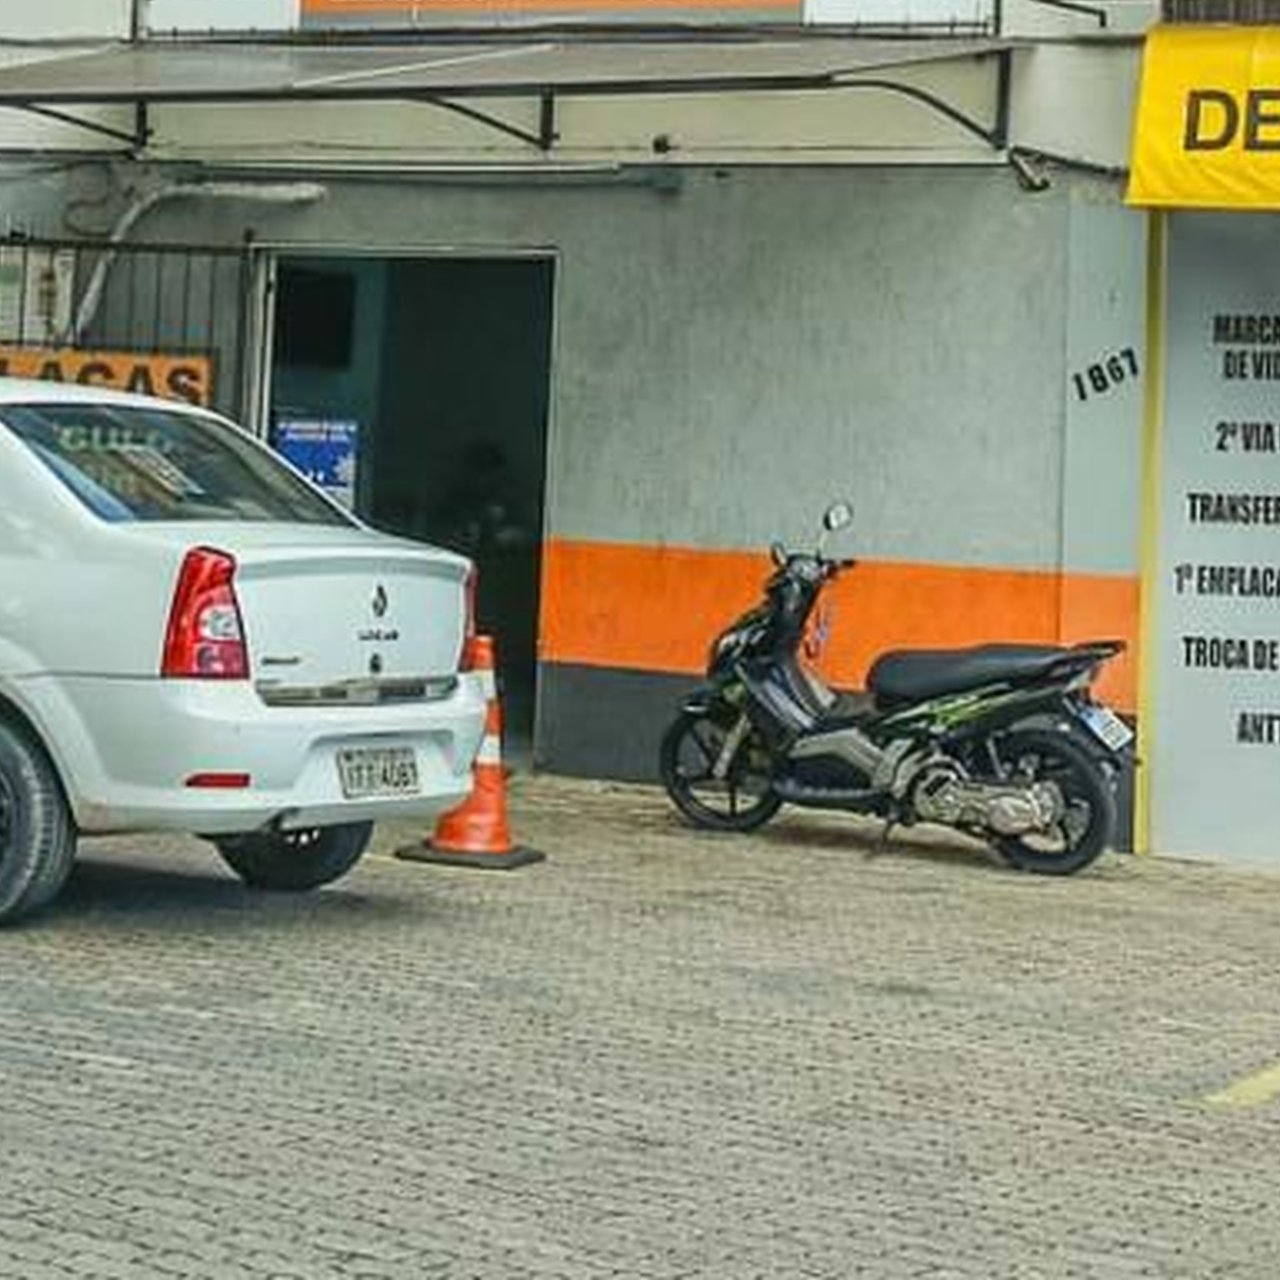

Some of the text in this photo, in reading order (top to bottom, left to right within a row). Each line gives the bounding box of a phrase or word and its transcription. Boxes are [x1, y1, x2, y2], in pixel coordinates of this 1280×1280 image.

[1072, 348, 1140, 402] 1867
[1224, 350, 1248, 380] DE
[1243, 423, 1275, 453] VIA
[1182, 636, 1250, 670] TROCA
[1253, 639, 1279, 671] DE
